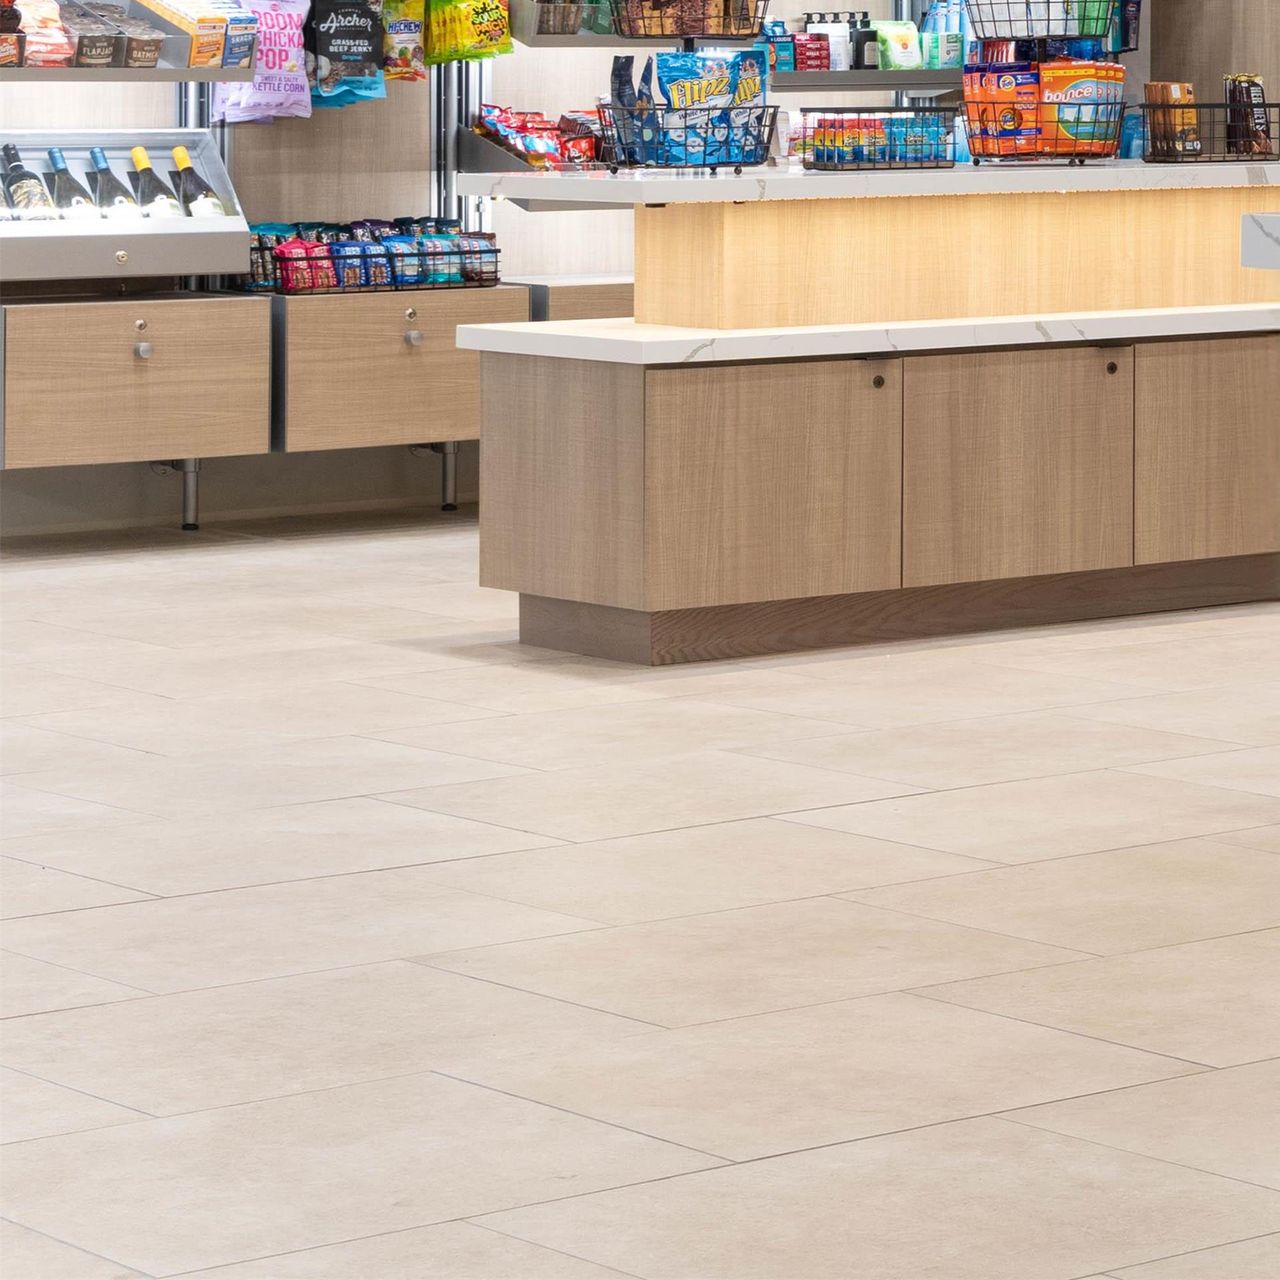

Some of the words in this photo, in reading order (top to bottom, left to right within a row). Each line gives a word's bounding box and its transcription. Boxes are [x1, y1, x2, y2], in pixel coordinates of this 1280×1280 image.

[319, 12, 372, 34] Archer
[472, 8, 502, 24] SOUR
[387, 21, 422, 35] HI-CHEW
[476, 19, 507, 37] PATCH
[83, 46, 114, 56] FLAPJAC
[256, 48, 290, 70] POP
[252, 82, 282, 92] KETTLE
[283, 83, 305, 93] CORN
[670, 76, 730, 110] Flipz
[1043, 85, 1094, 103] bounce
[1250, 86, 1266, 131] HERHEY'S
